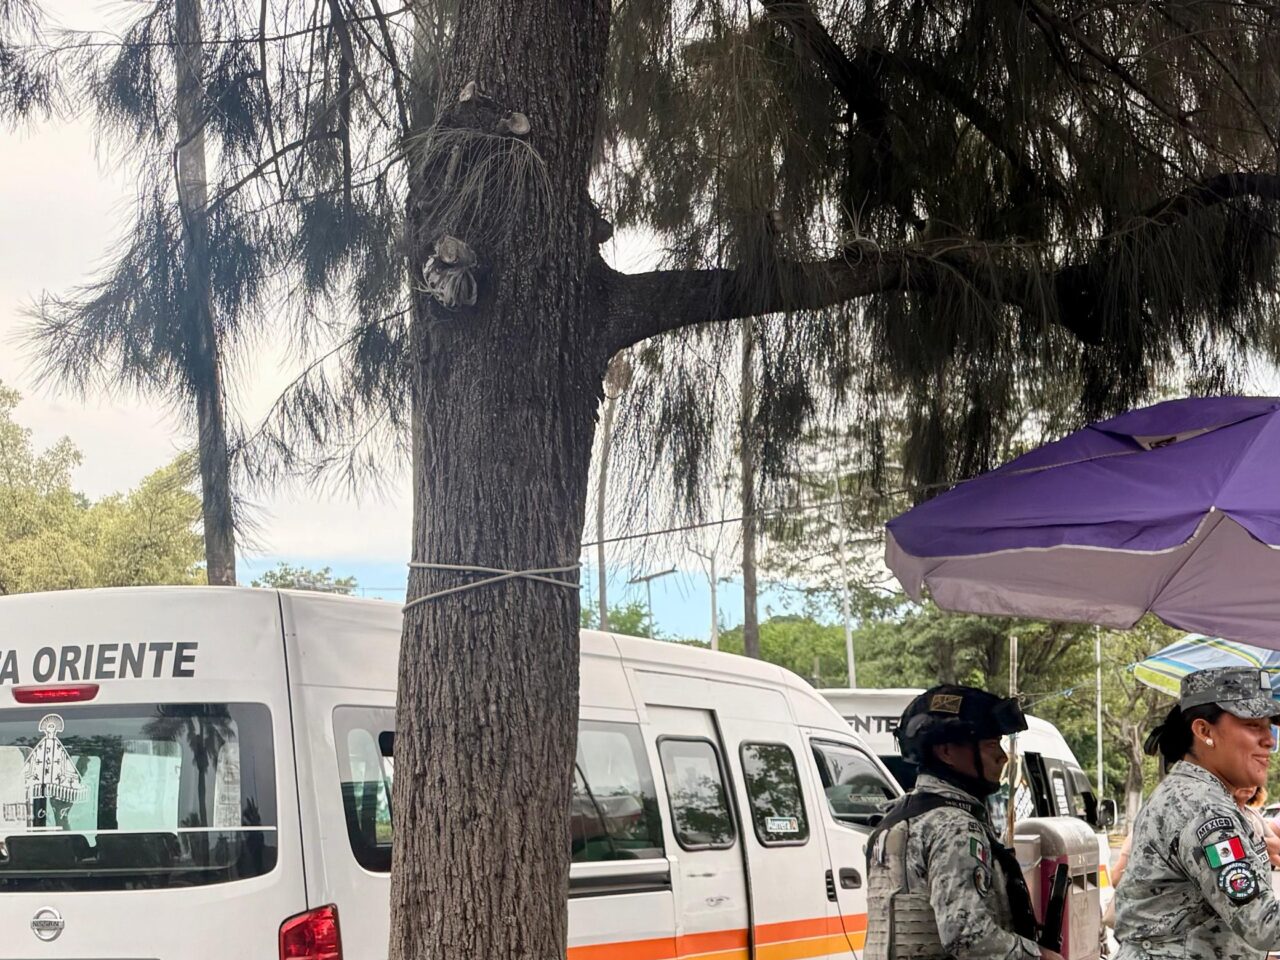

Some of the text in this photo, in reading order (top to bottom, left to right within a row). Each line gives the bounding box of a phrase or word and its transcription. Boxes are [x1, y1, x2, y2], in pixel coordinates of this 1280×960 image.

[0, 642, 199, 685] A ORIENTE
[1198, 818, 1231, 837] MEXICO
